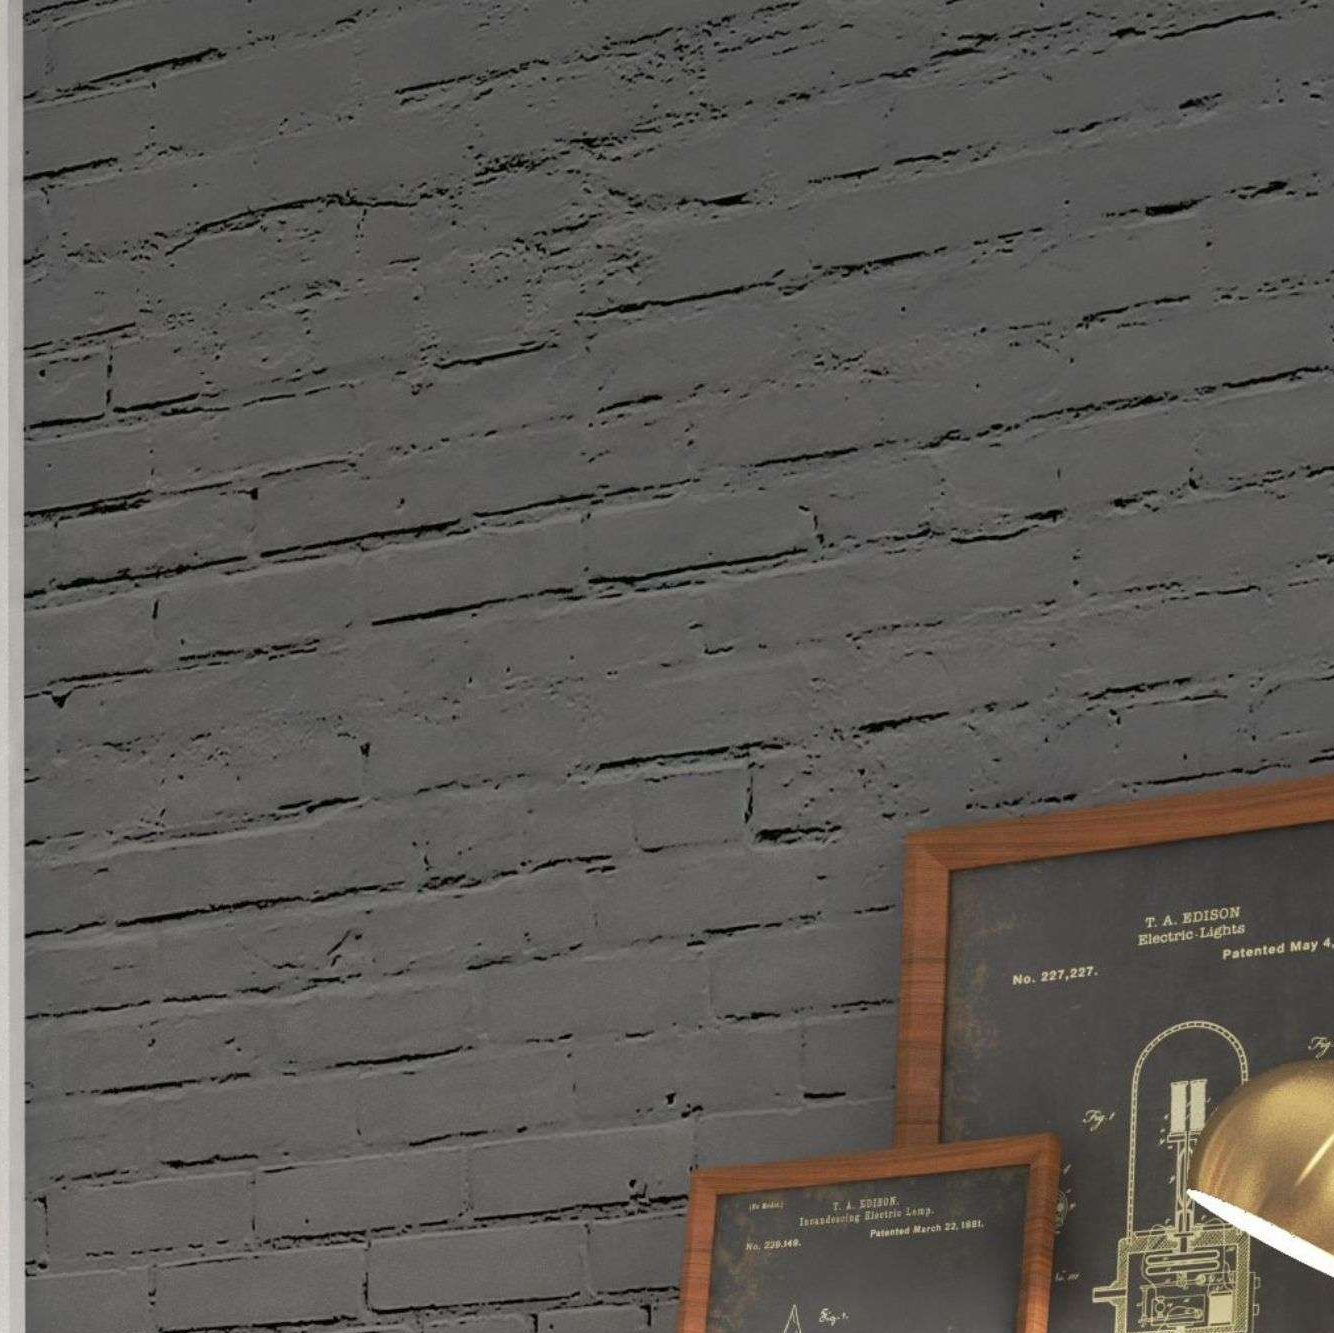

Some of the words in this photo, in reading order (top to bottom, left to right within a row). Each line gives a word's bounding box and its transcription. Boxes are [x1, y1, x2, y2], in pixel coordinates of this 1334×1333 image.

[1145, 917, 1158, 928] T.
[1163, 915, 1178, 926] A.
[1183, 907, 1240, 924] EDISON
[1222, 942, 1285, 960] Patented
[1290, 939, 1318, 952] May
[1012, 974, 1035, 985] No.
[870, 1226, 910, 1238] Patented
[913, 1223, 942, 1234] March
